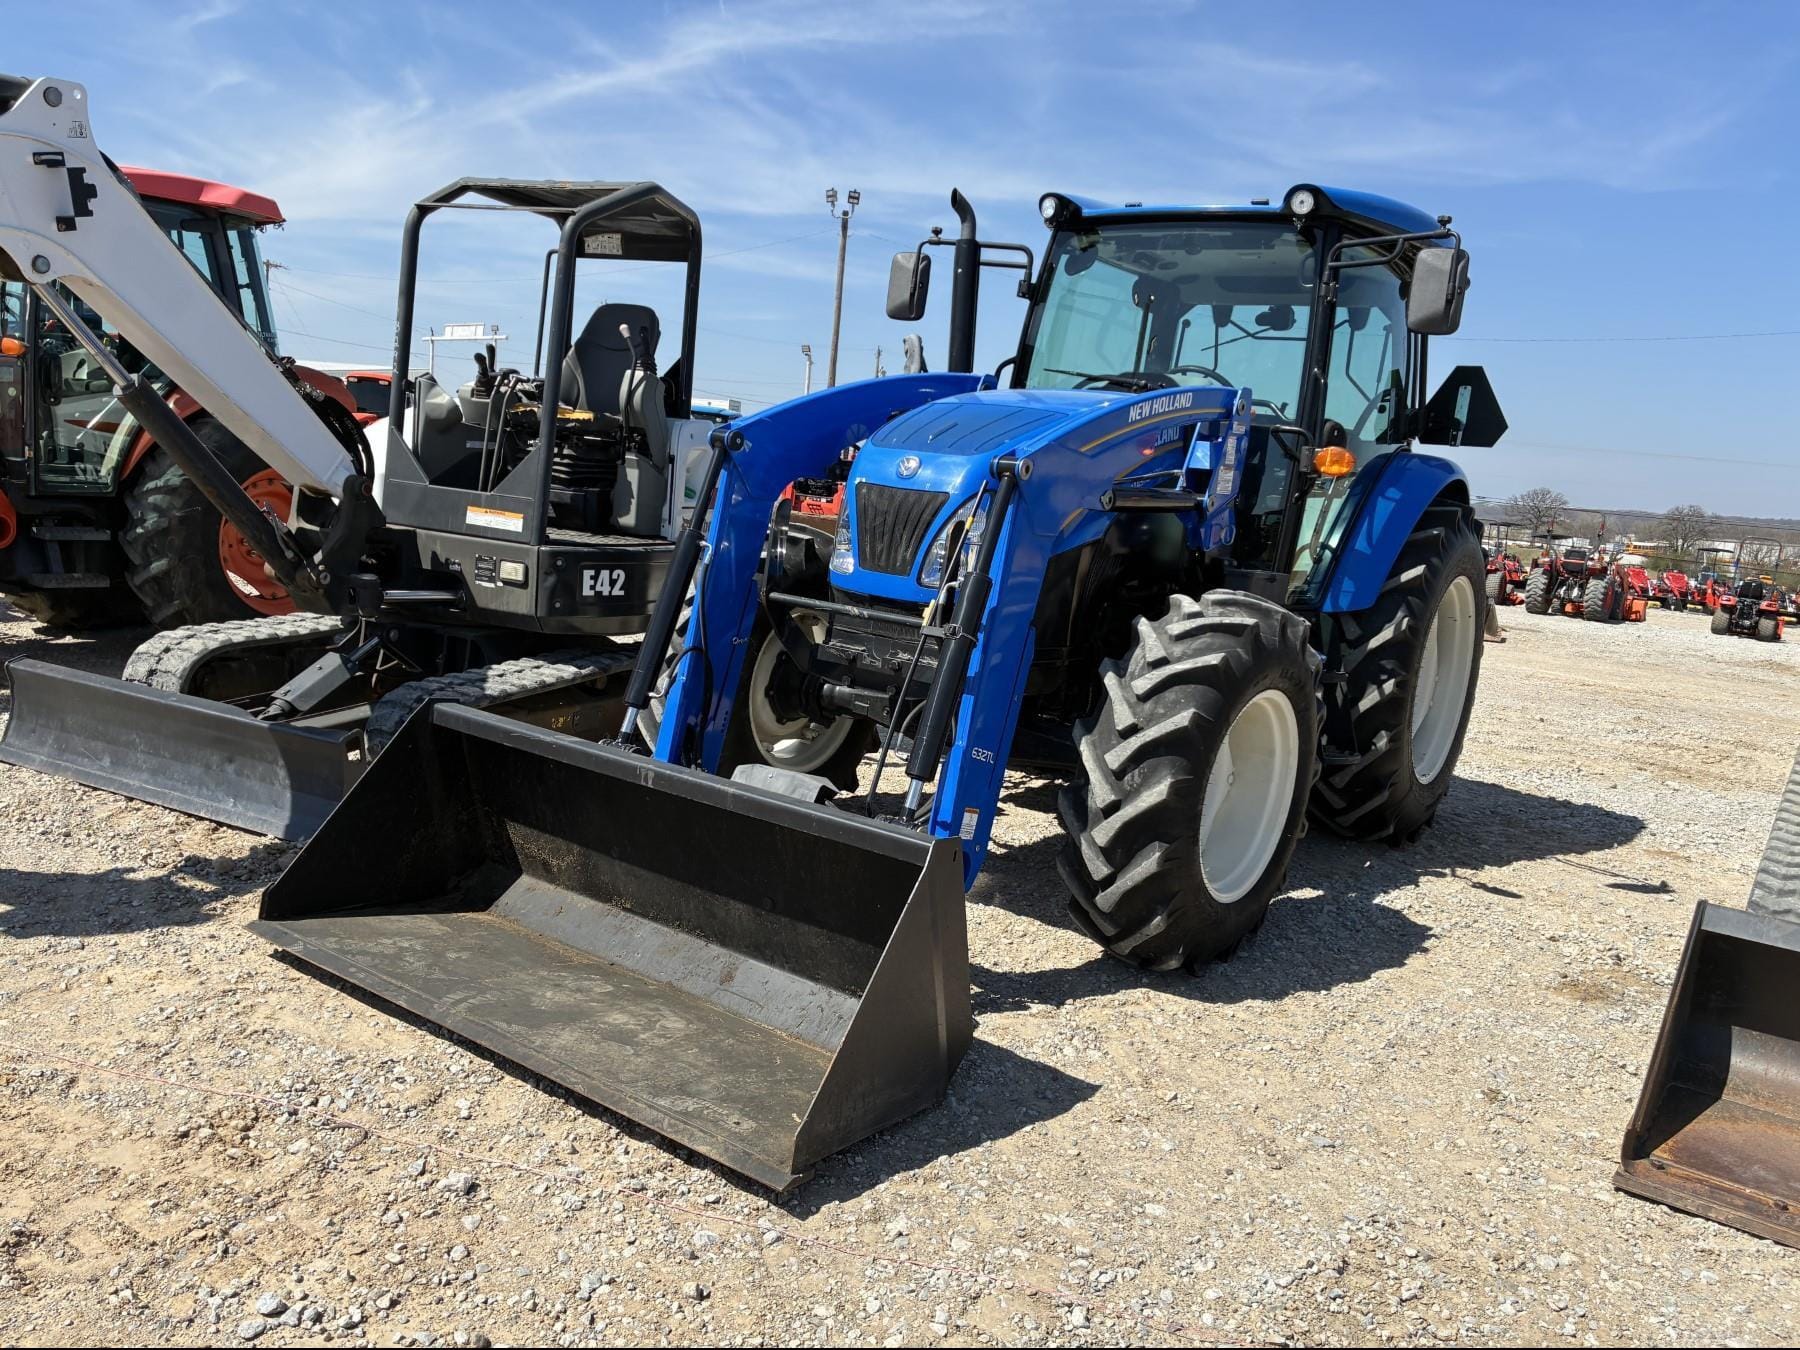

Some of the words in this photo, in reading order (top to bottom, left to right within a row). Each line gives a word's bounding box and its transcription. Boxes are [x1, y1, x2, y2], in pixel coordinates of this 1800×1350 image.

[1128, 399, 1152, 423] NEW
[1151, 392, 1193, 415] HOLLAND
[582, 569, 626, 597] E42
[971, 747, 994, 764] 632TL
